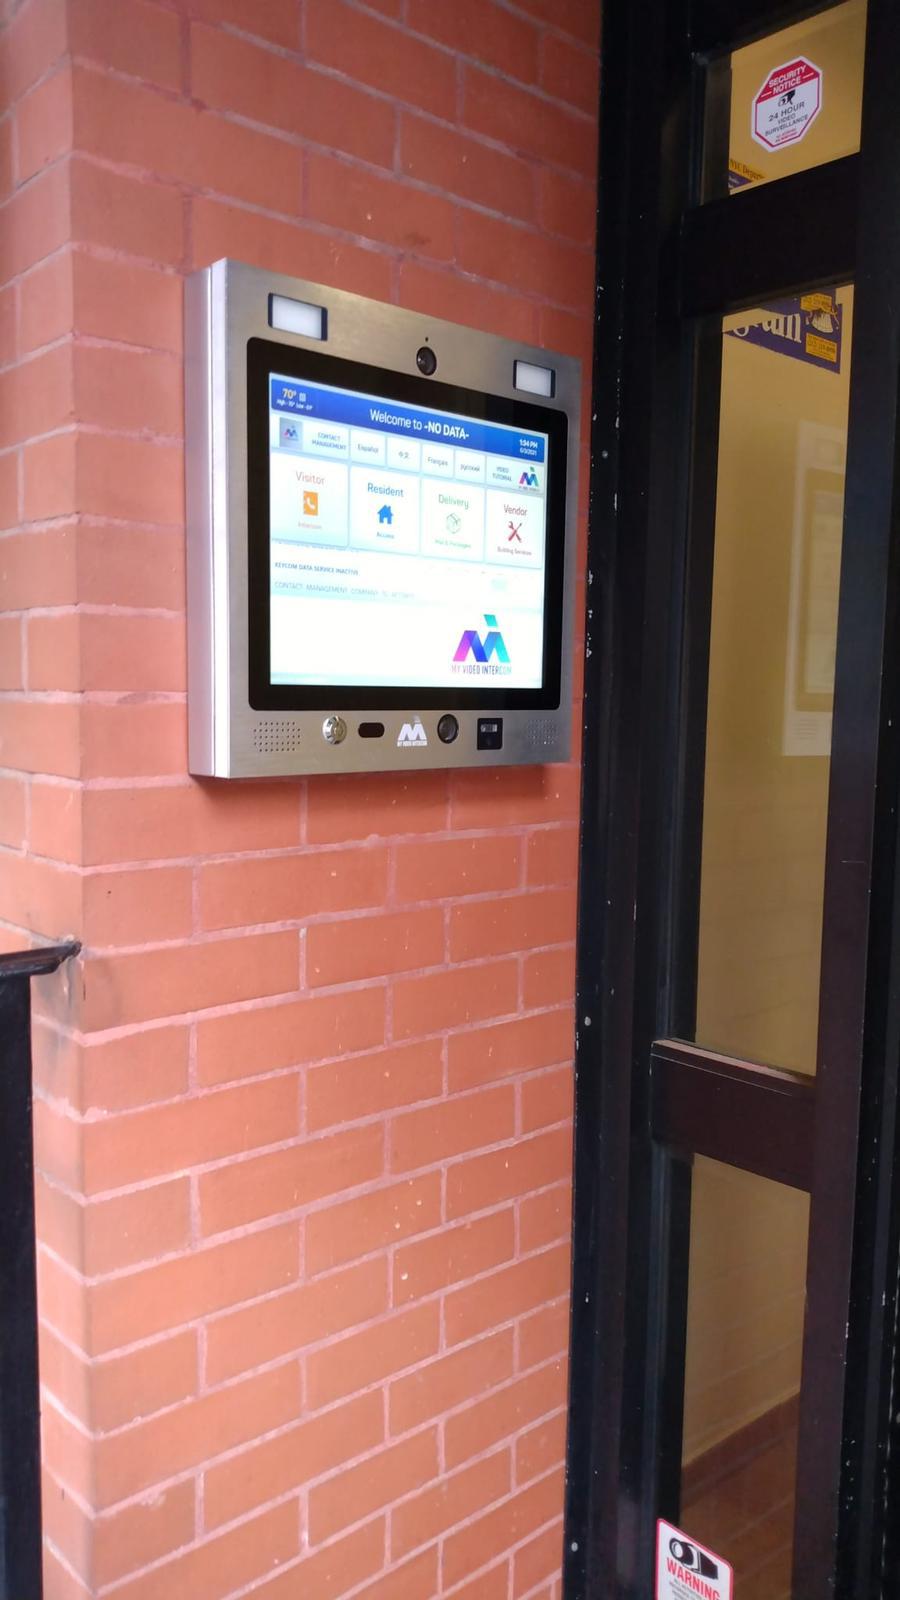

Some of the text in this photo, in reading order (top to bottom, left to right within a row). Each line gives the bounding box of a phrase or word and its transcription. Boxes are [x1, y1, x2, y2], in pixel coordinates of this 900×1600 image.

[768, 65, 807, 88] SECURITY
[773, 76, 802, 94] NOTICE
[769, 101, 805, 122] 24 HOUR
[778, 113, 797, 125] VIDEO
[765, 114, 809, 136] SURVEILLANCE
[369, 408, 470, 439] Welcome to -NO DATA-
[317, 431, 341, 442] CONTACT
[311, 439, 347, 451] MANAGEMENT
[296, 470, 326, 486] Visitor
[367, 482, 405, 498] Resident
[438, 494, 470, 510] Delivery
[503, 504, 528, 516] Vendor
[299, 563, 313, 571] DATA
[274, 581, 304, 590] CONTACT
[306, 583, 348, 594] MANAGEMENT
[451, 664, 512, 676] MY VIDEO INTERCOM
[667, 1557, 720, 1600] WARNING
